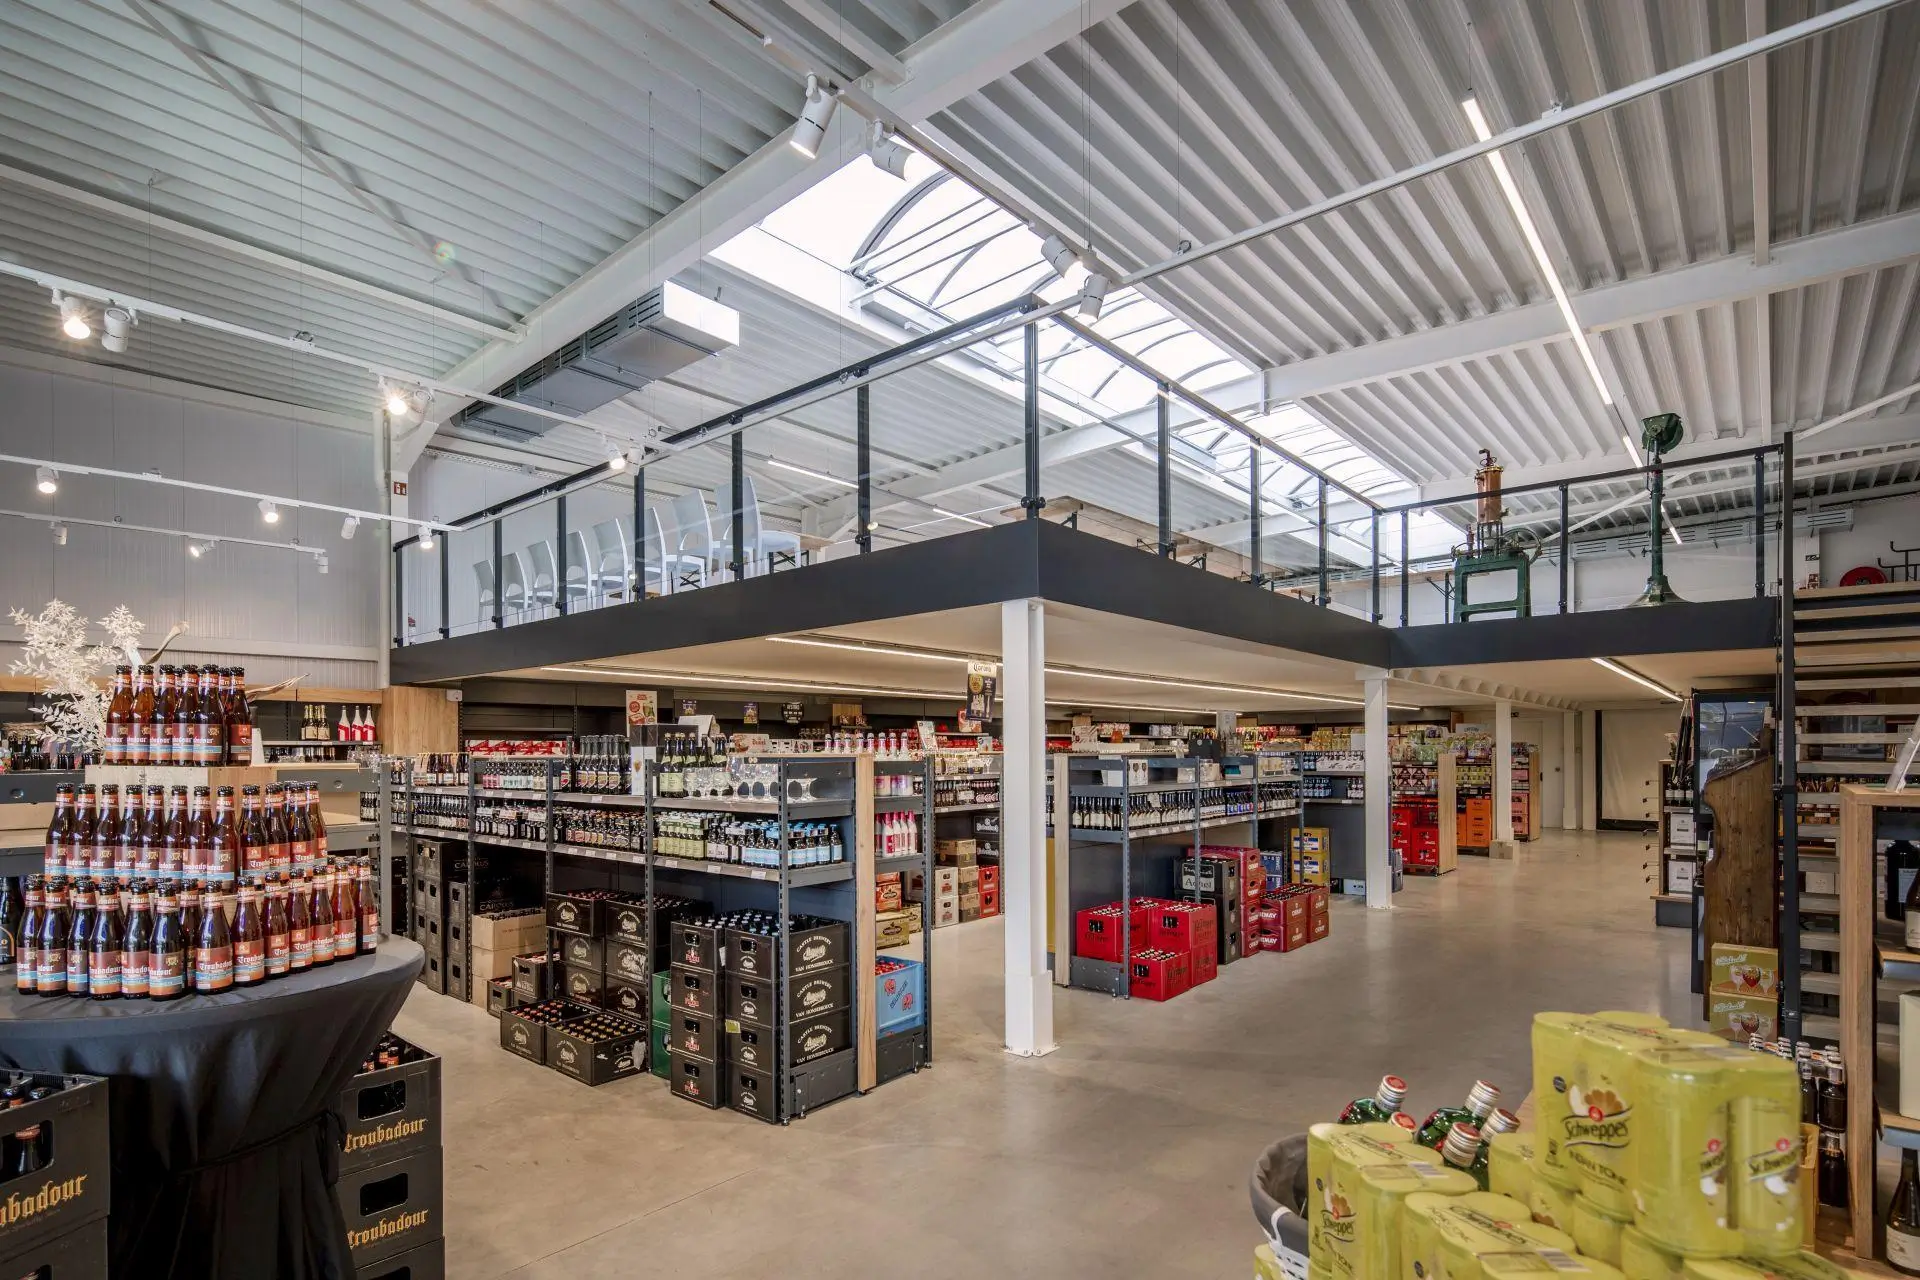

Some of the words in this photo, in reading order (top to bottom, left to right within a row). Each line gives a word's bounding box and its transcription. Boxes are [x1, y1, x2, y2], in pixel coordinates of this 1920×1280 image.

[796, 937, 812, 953] CASTLE
[796, 982, 813, 998] CASTLE
[797, 1026, 813, 1044] CASTLE
[1565, 1119, 1629, 1142] Schweppes
